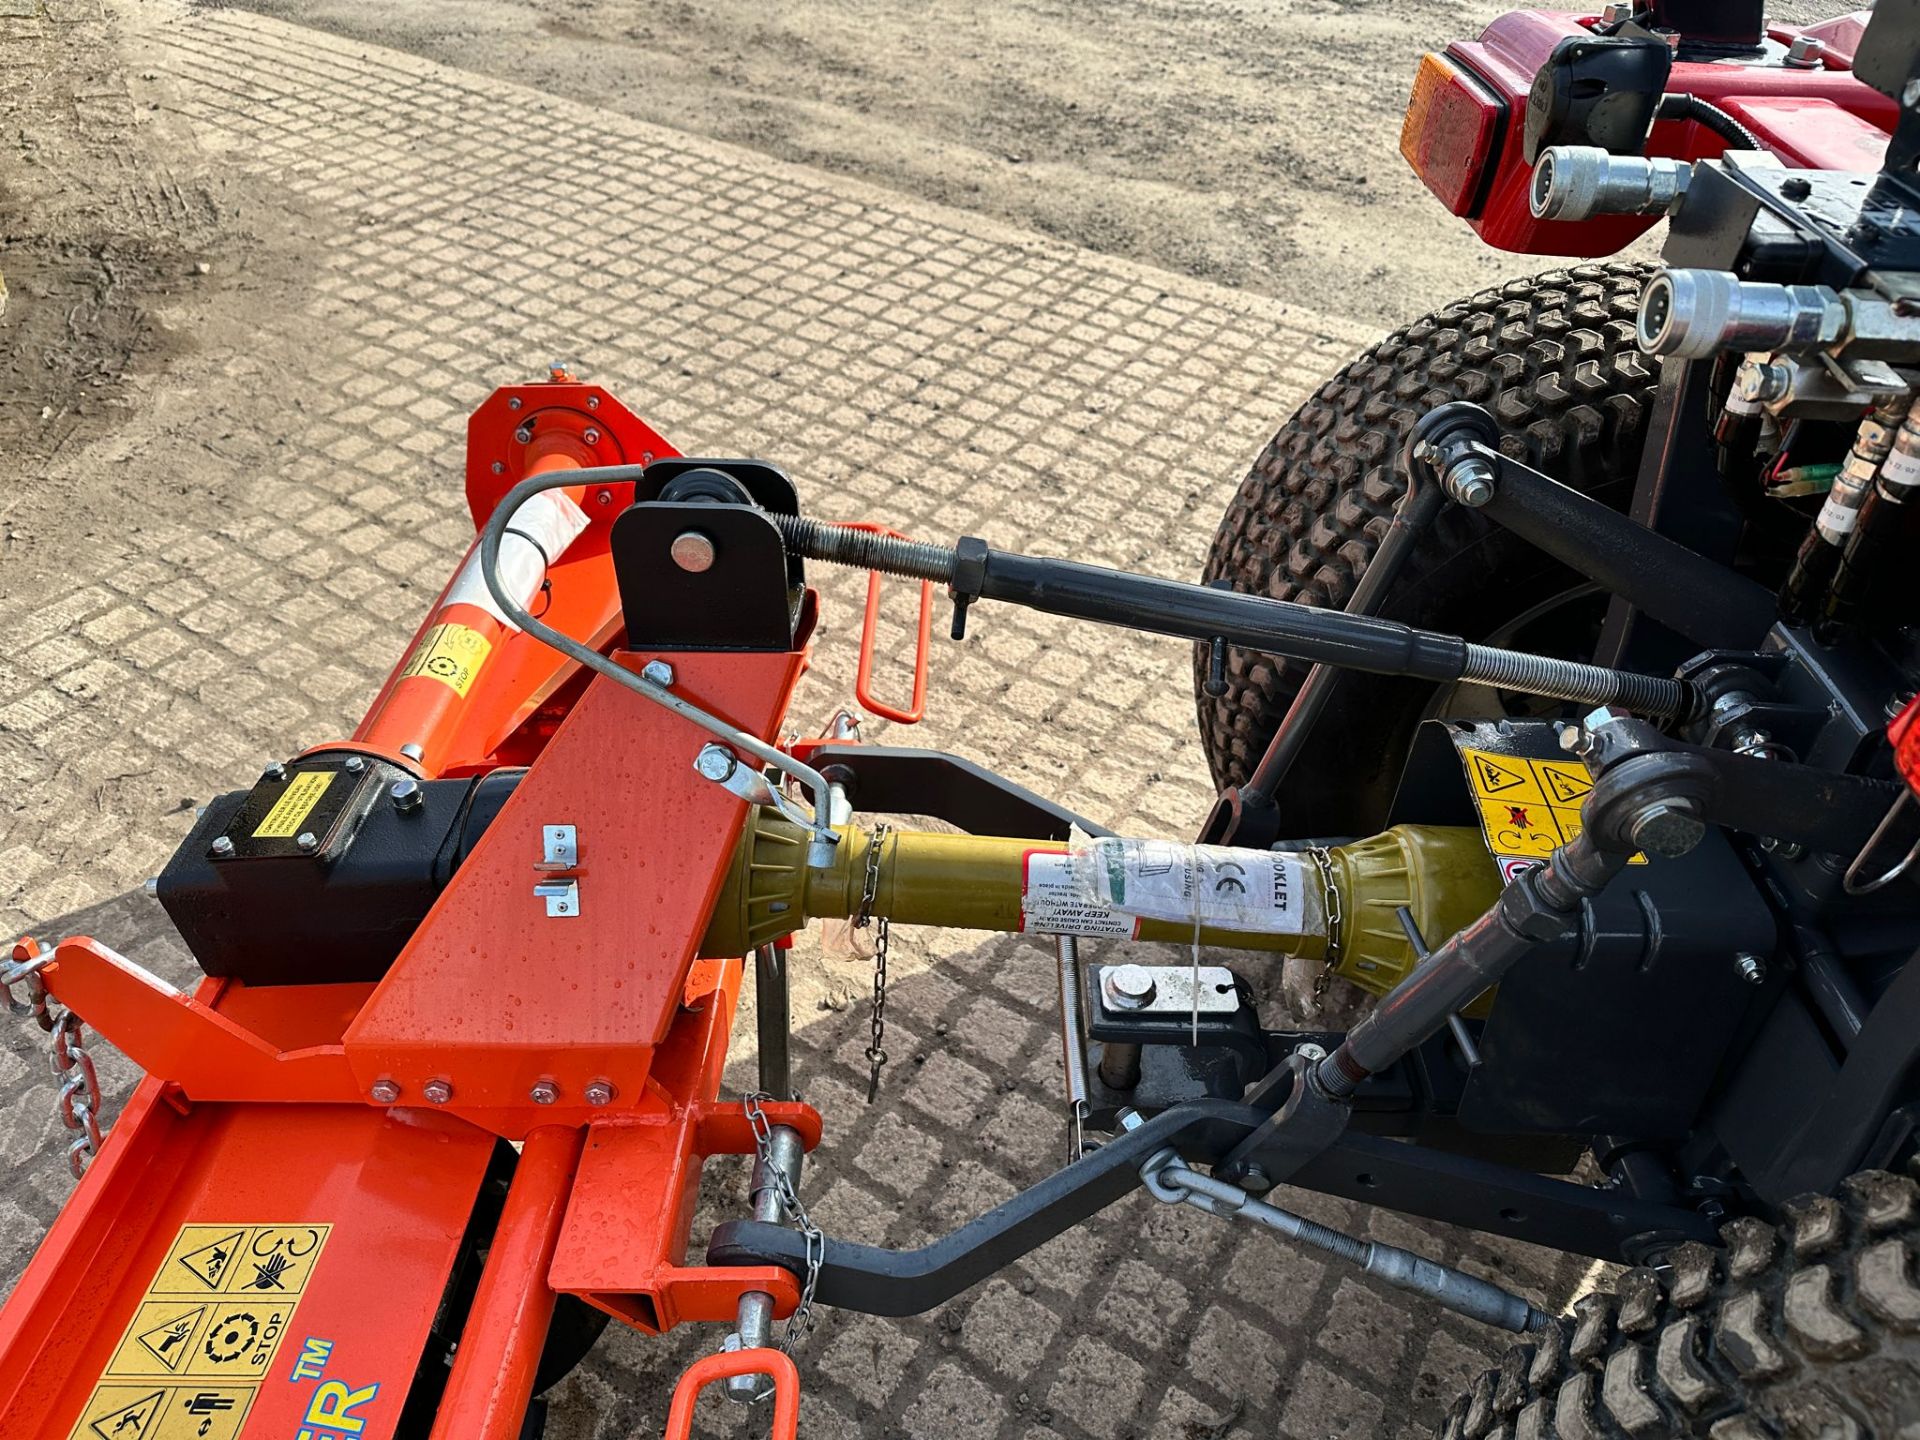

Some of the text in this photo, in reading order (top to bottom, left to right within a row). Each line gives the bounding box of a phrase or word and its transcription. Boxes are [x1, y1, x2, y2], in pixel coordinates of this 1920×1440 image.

[455, 667, 470, 689] STOP
[1184, 868, 1192, 898] USING
[1052, 908, 1110, 918] KEEP AWAY!
[1083, 925, 1128, 933] ROTATING
[251, 1313, 282, 1365] STOP
[289, 1336, 336, 1383] TM
